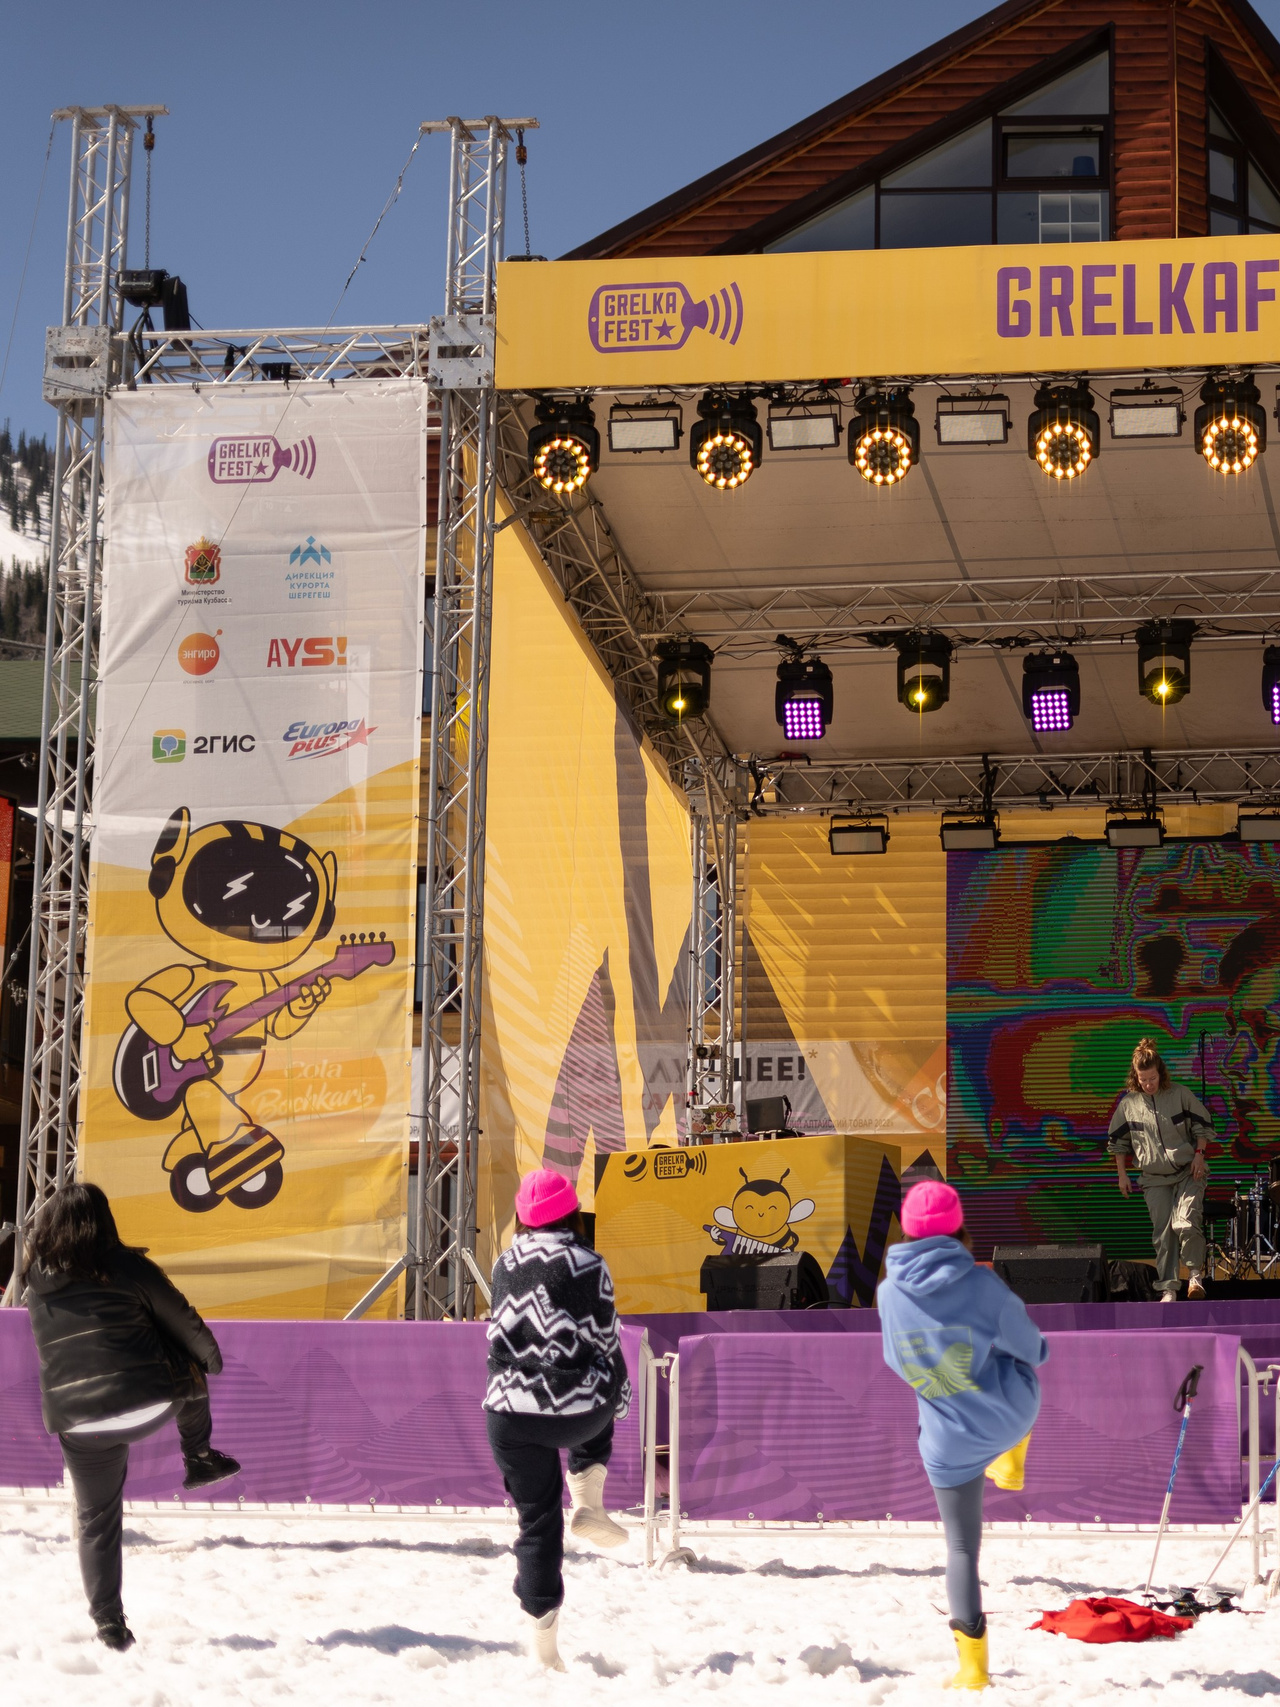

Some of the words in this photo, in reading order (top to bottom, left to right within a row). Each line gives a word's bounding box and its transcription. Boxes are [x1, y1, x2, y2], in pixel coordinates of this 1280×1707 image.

[603, 292, 678, 317] GRELKA
[603, 319, 653, 344] FEST
[218, 441, 271, 459] GRELKA
[218, 460, 253, 477] FEST
[285, 572, 335, 581] ДИРЕКЦИЯ
[181, 589, 225, 597] Министерство
[289, 582, 330, 590] КУРОРТА
[288, 592, 331, 600] ШЕРЕГЕШ
[182, 649, 217, 661] энгиро
[266, 636, 348, 668] AYS!
[282, 718, 362, 742] Europa
[193, 733, 256, 755] 2ГИС
[284, 1058, 343, 1079] Cola
[658, 1155, 685, 1166] GRELKA
[659, 1166, 677, 1176] FEST
